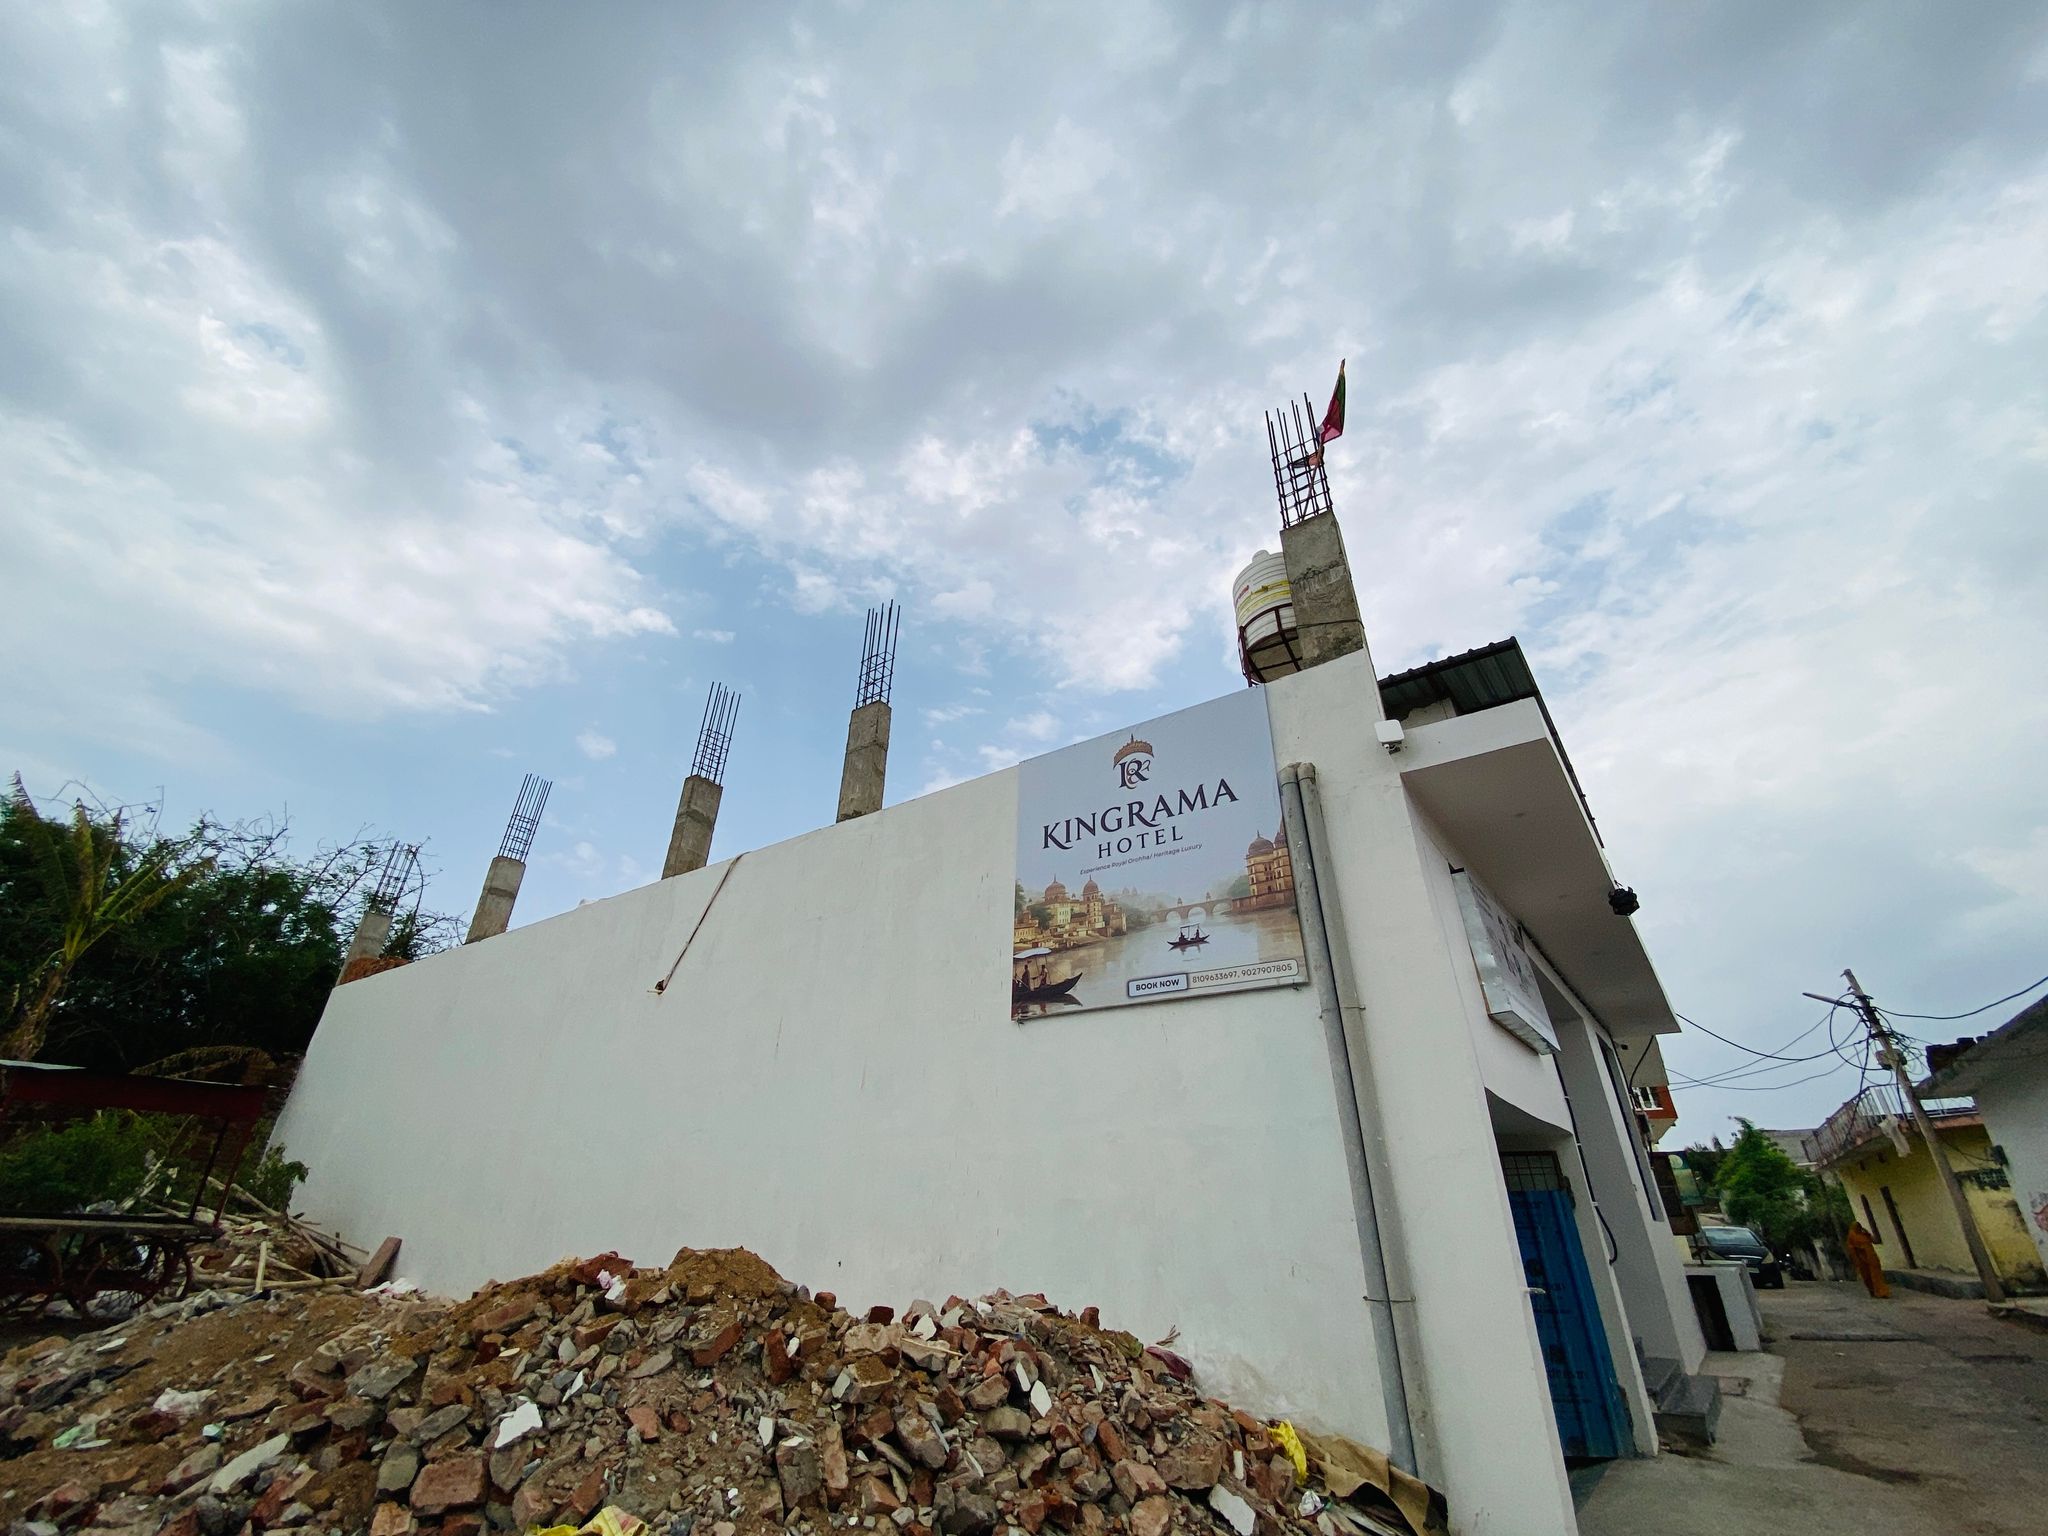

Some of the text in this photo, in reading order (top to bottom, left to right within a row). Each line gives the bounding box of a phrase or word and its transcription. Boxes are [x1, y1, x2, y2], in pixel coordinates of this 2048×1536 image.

[1042, 778, 1239, 850] KINGRAMA
[1098, 825, 1184, 859] HOTEL
[1079, 863, 1111, 875] Experience
[1111, 860, 1127, 869] Royal
[1153, 848, 1180, 859] Heritage
[1180, 843, 1203, 853] Luxury
[1135, 978, 1180, 991] BOOK NOW
[1241, 963, 1293, 977] 9027907805
